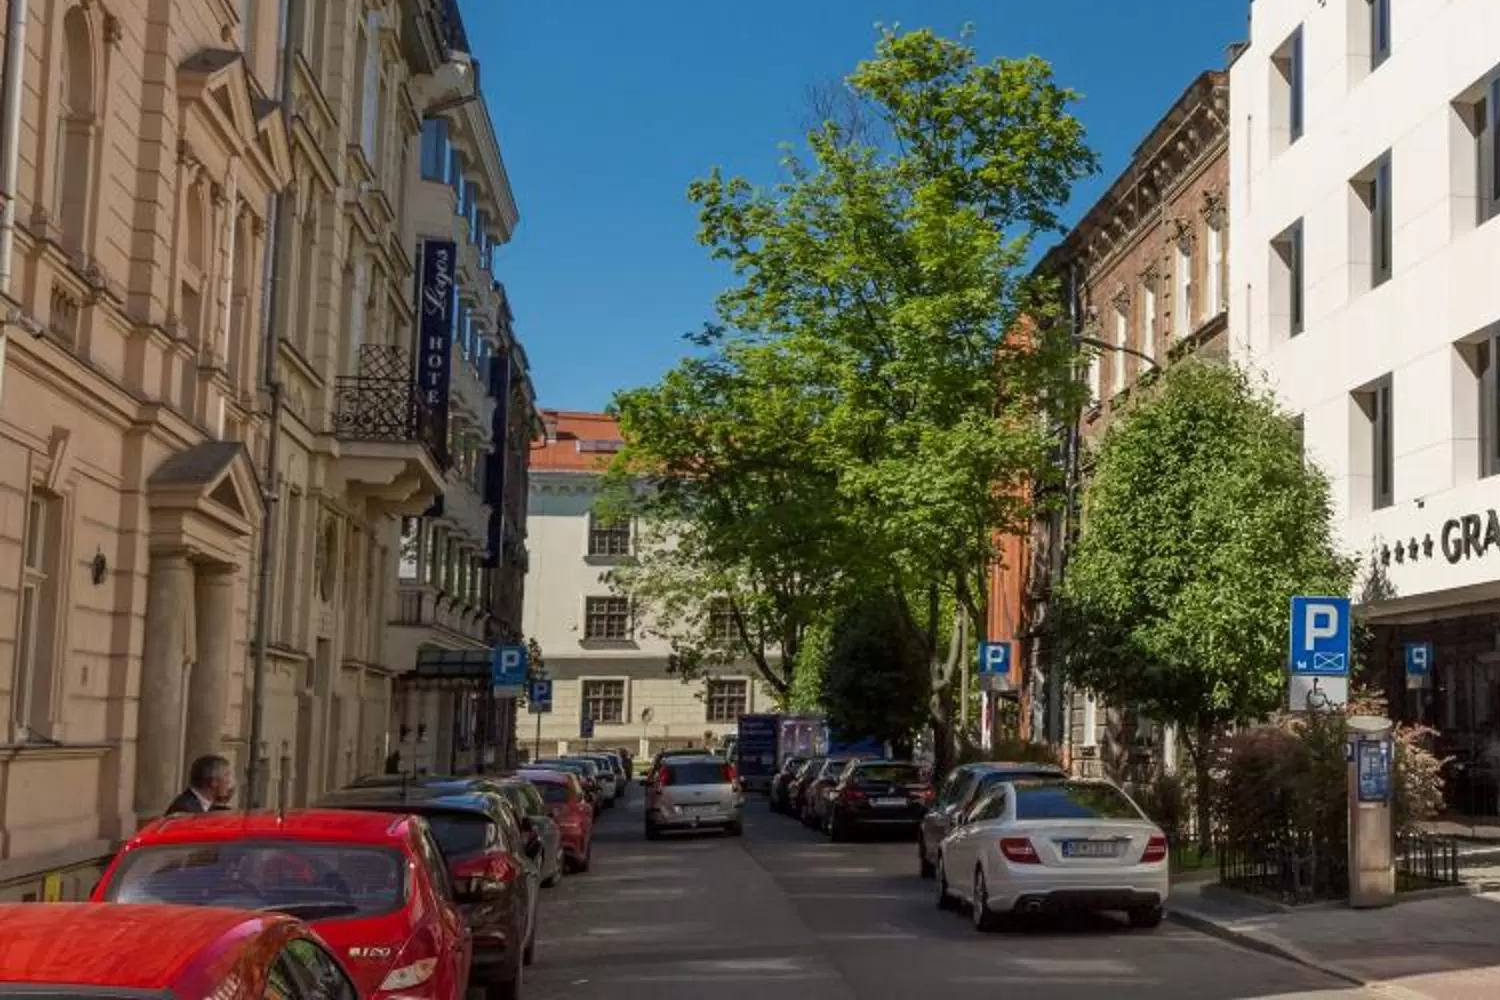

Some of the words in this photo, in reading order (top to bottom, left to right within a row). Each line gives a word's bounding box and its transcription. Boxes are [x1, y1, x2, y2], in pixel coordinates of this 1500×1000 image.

[426, 336, 442, 420] HOTE
[1304, 603, 1338, 651] P
[501, 649, 521, 674] P
[986, 645, 1004, 671] P
[533, 682, 548, 701] P
